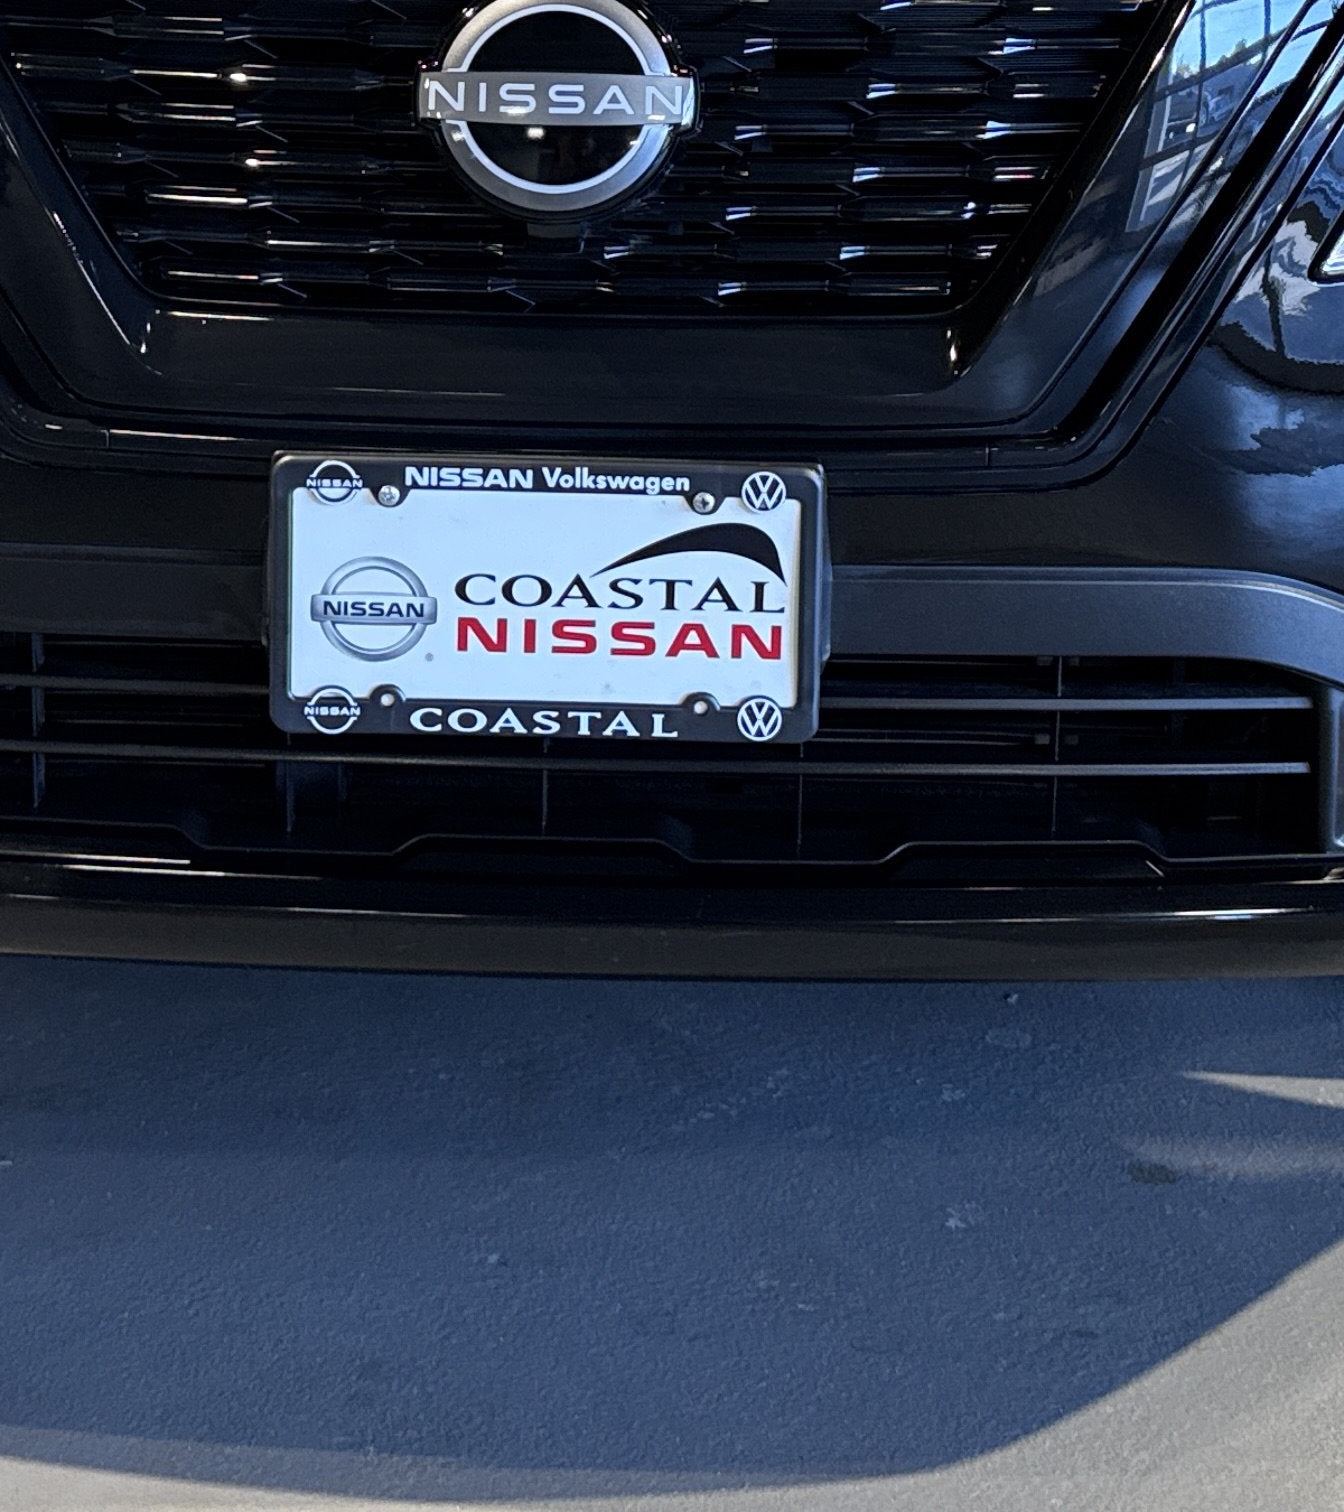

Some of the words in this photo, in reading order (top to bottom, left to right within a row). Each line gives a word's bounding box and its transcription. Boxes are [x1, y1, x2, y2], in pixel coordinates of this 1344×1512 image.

[427, 80, 683, 115] NISSAN
[306, 477, 364, 489] NISSAN
[405, 466, 533, 489] NISSAN
[542, 467, 690, 495] Volkswagen
[454, 573, 785, 613] COASTAL
[323, 600, 424, 618] NISSAN
[457, 617, 782, 660] NISSAN
[303, 705, 361, 717] NISSAN
[409, 707, 679, 738] COASTAL
